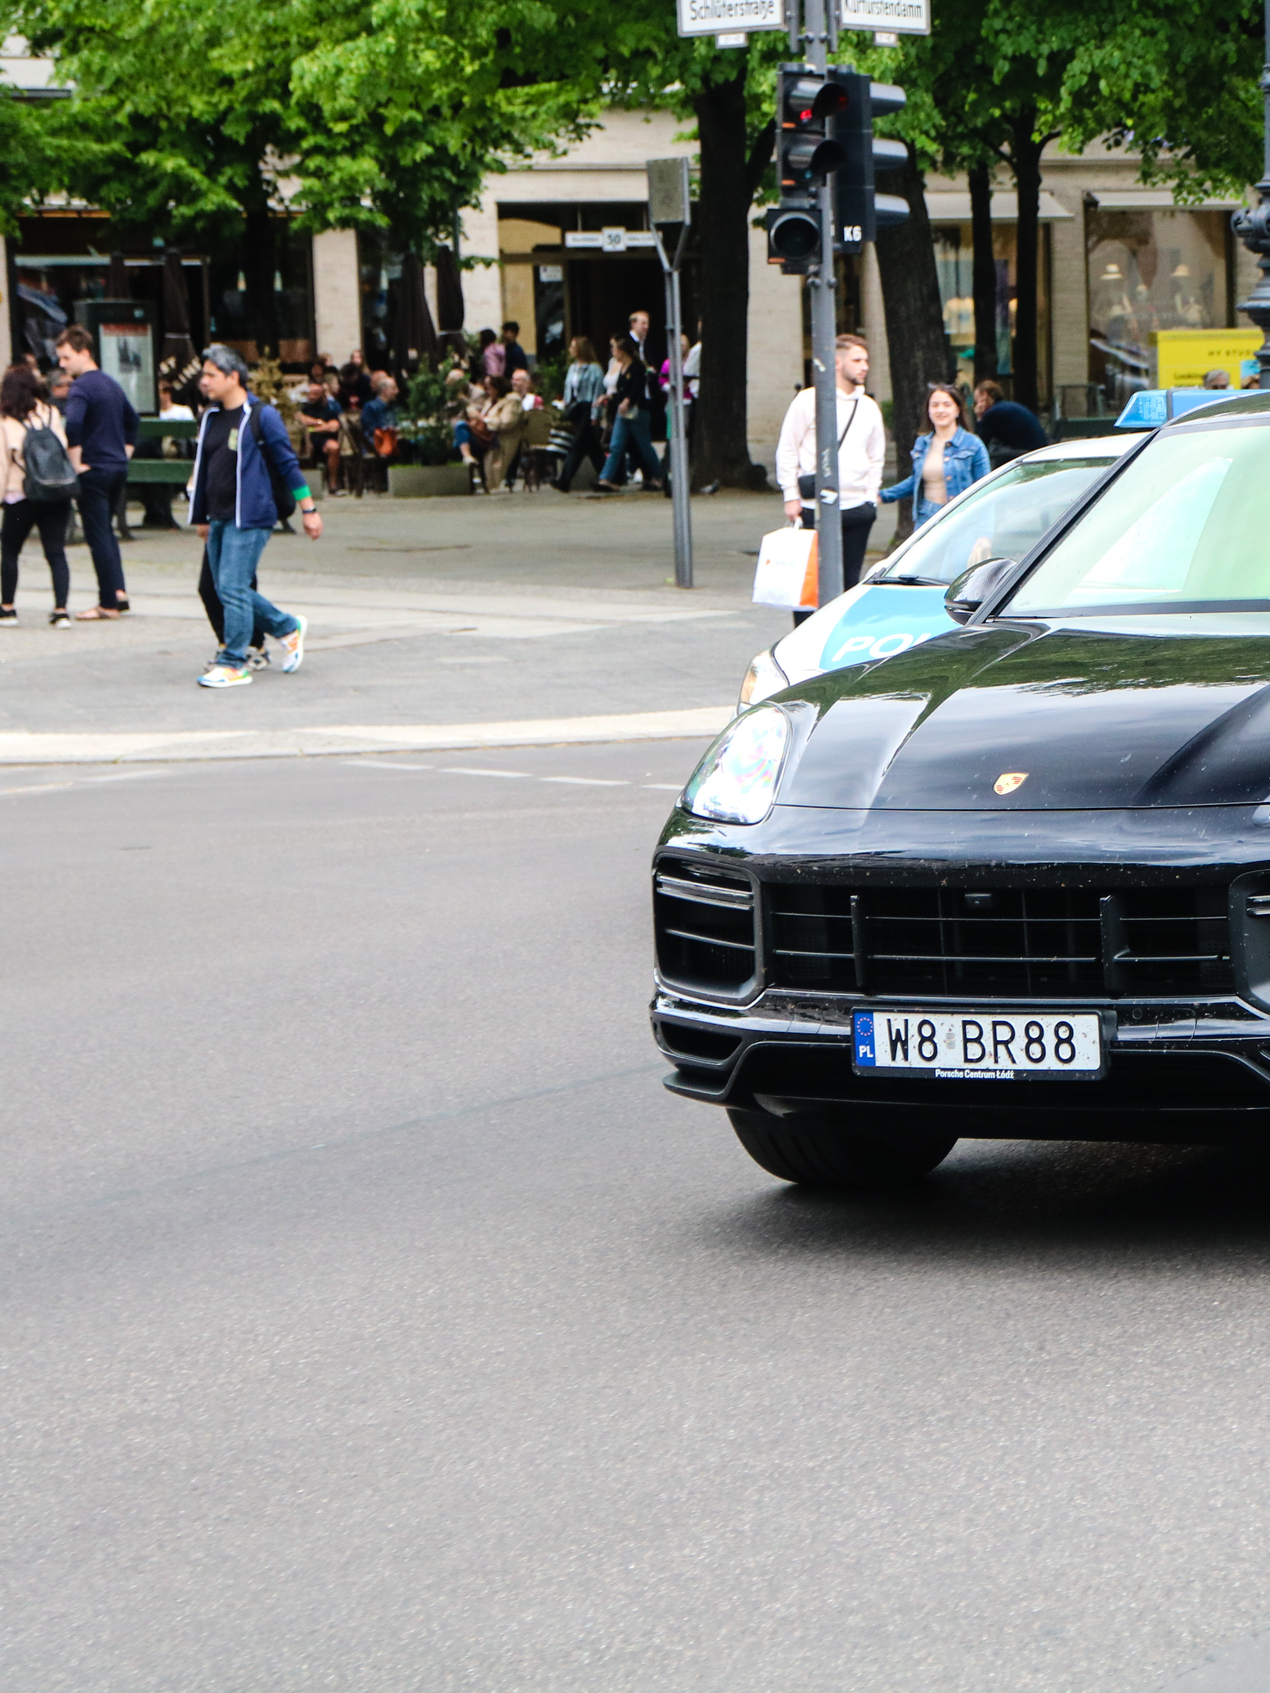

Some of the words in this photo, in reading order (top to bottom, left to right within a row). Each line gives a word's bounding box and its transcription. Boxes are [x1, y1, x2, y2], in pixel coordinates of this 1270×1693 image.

[843, 225, 862, 242] K6
[886, 1018, 938, 1062] W8
[961, 1019, 1076, 1064] BR88
[859, 1045, 874, 1058] PL
[934, 1069, 963, 1078] Porsche
[964, 1070, 995, 1079] Centrum
